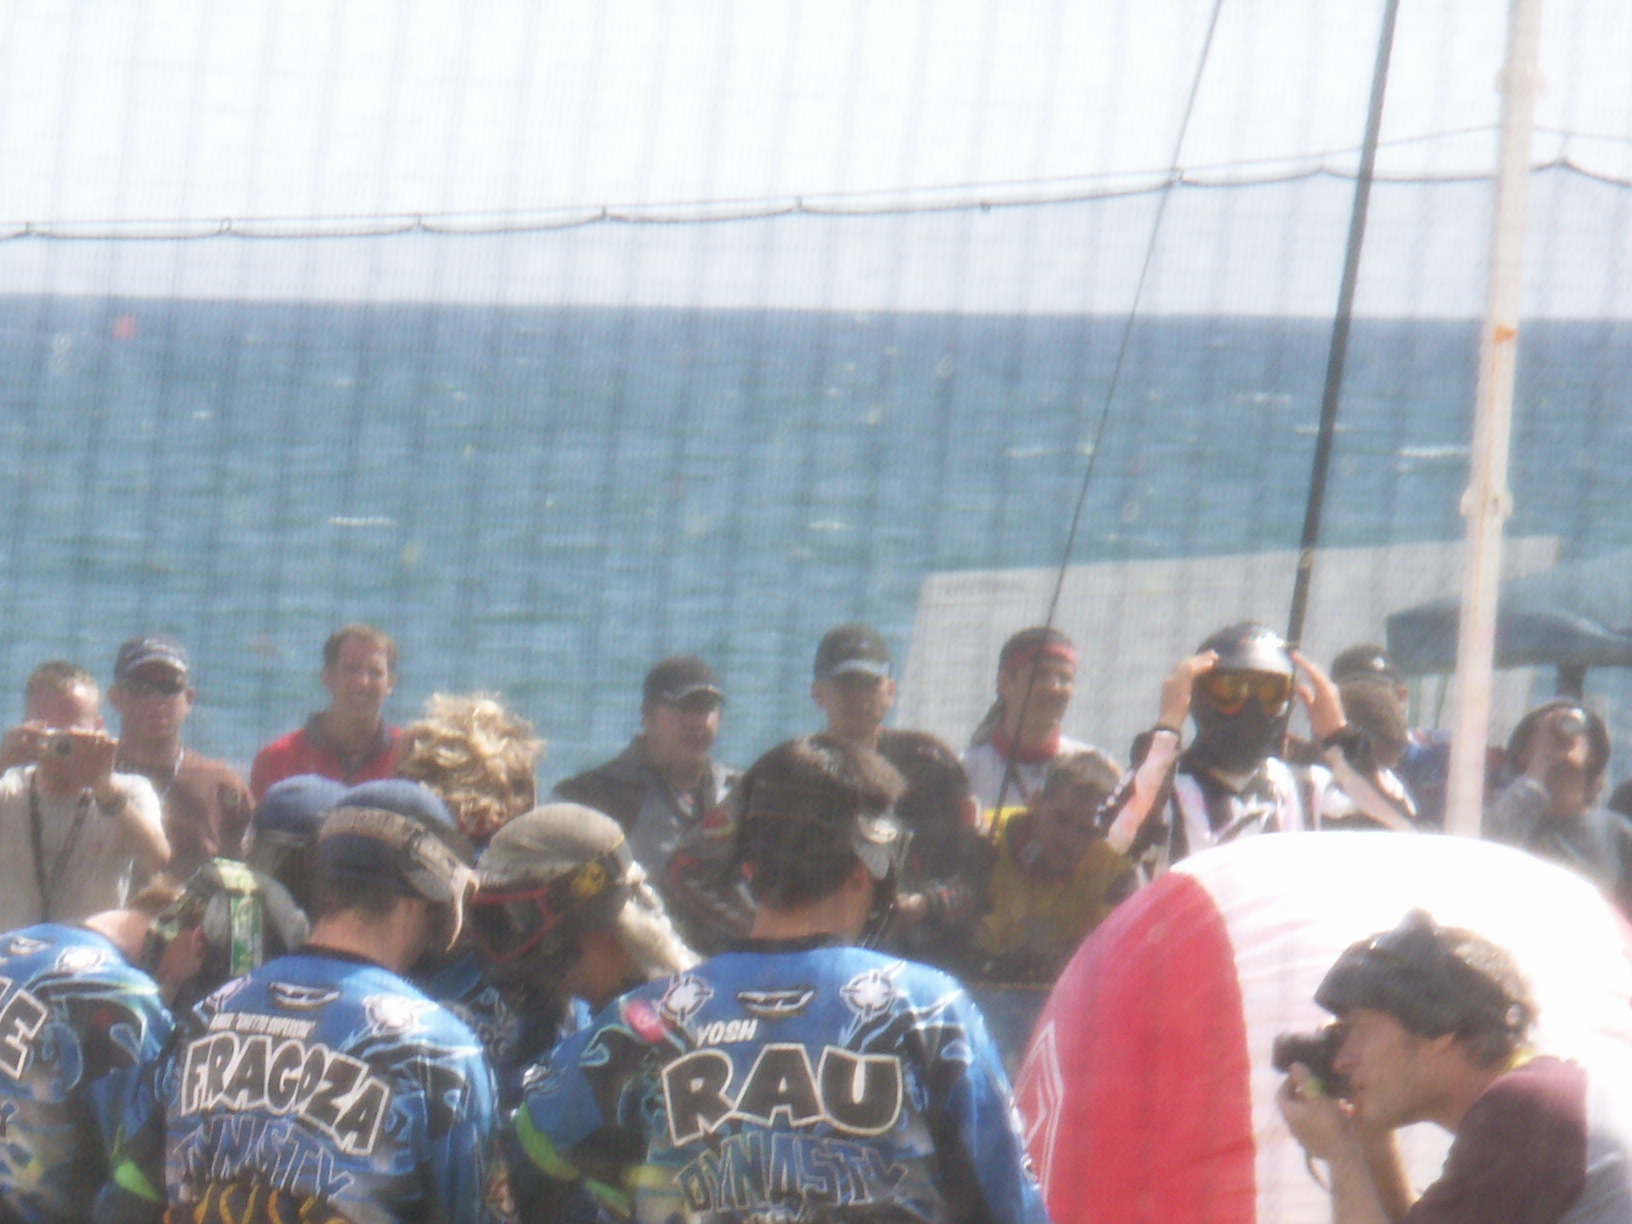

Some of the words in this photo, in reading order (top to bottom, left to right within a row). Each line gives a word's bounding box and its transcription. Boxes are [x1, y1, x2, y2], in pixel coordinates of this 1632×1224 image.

[696, 1018, 759, 1047] YOSH
[181, 1031, 390, 1157] FRAGOZA
[661, 1042, 903, 1147] RAU
